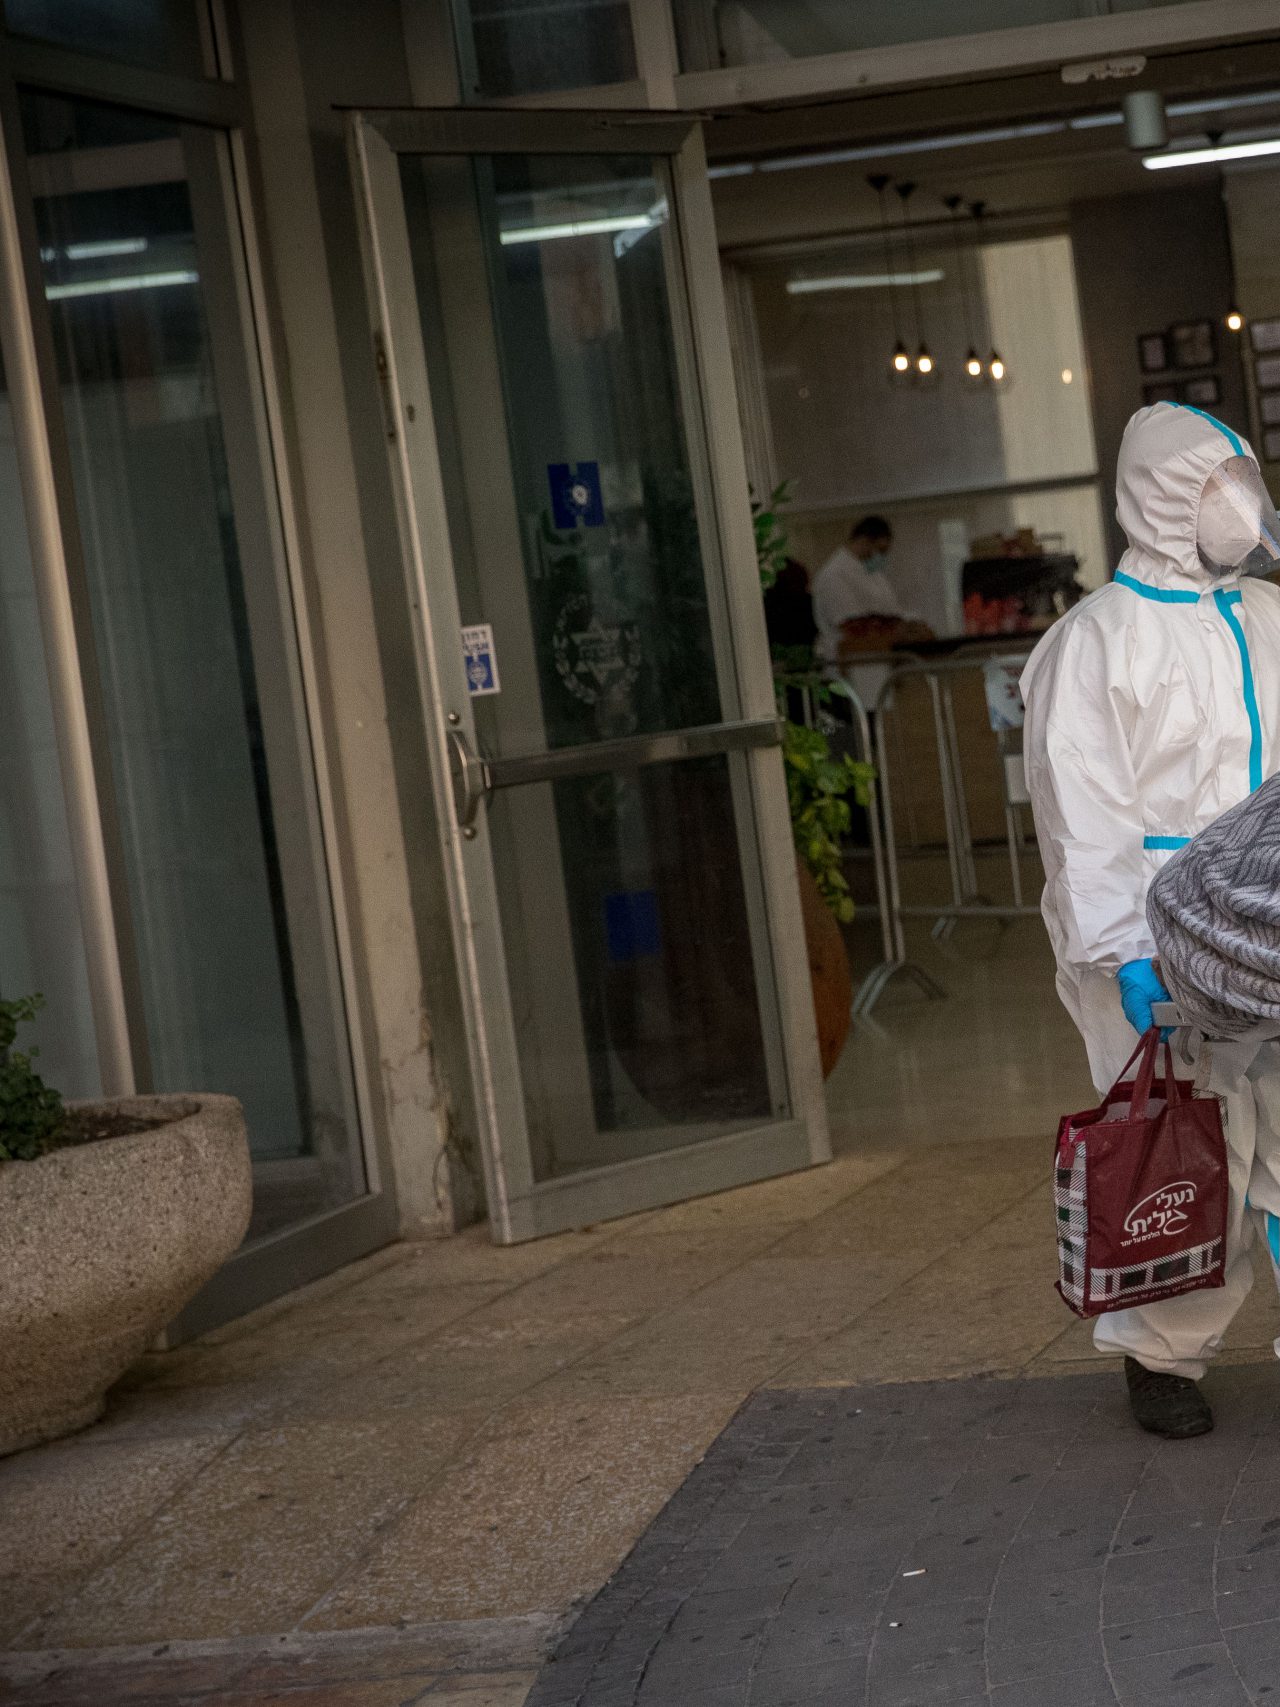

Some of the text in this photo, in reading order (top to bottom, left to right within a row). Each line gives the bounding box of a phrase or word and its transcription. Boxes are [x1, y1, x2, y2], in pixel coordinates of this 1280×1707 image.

[1156, 1188, 1195, 1209] נעלי
[1131, 1208, 1190, 1236] גילית
[1132, 1236, 1142, 1244] על
